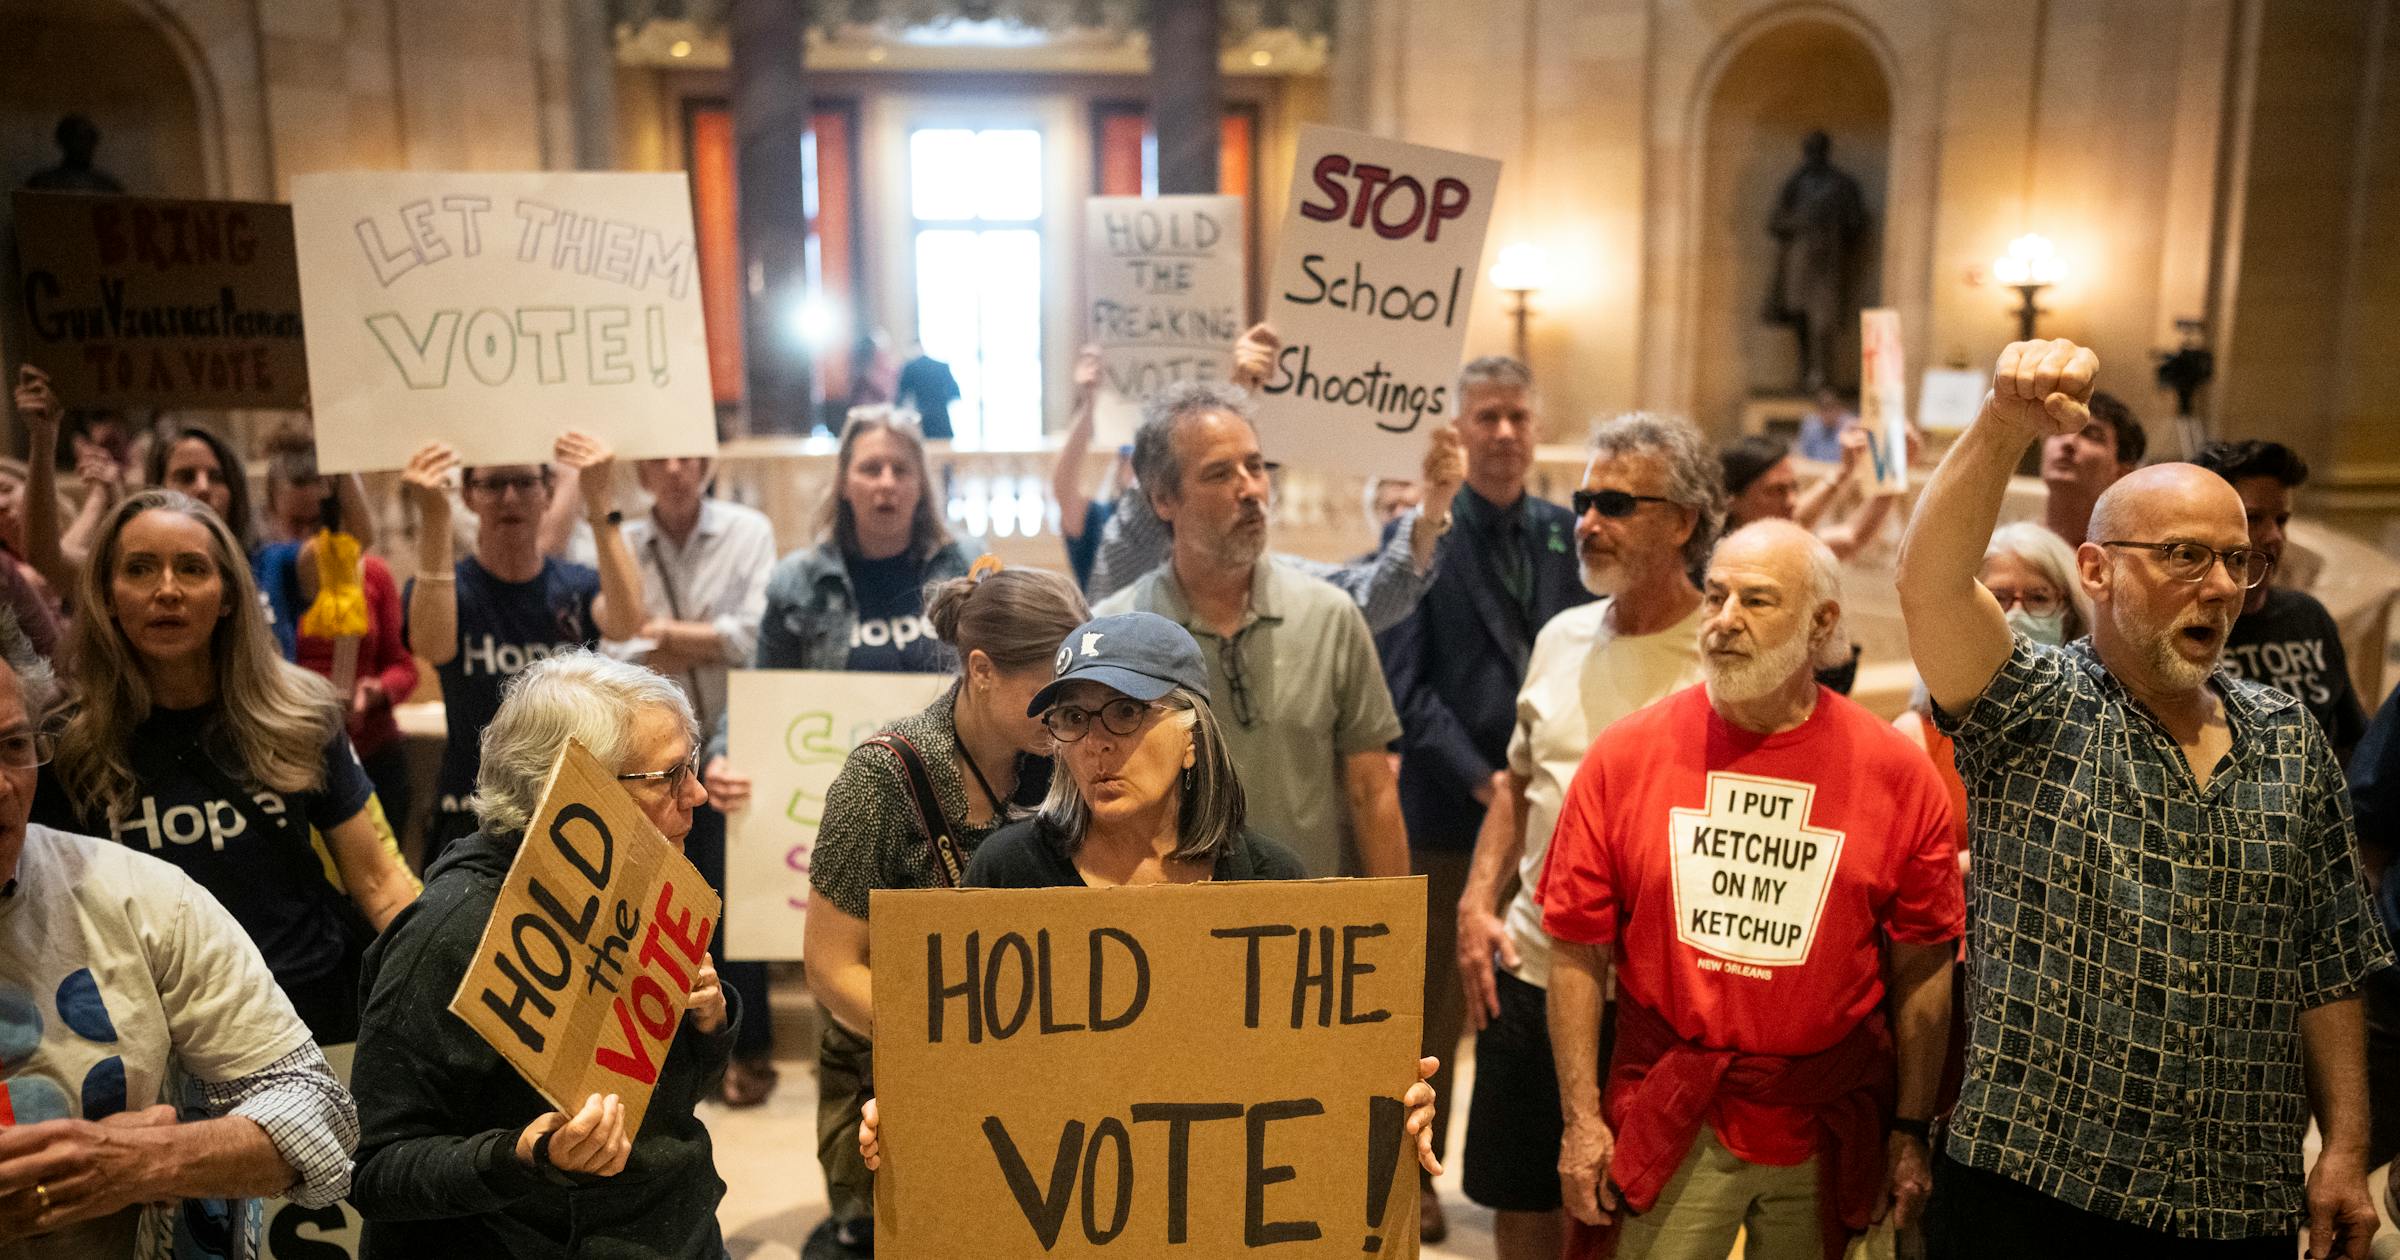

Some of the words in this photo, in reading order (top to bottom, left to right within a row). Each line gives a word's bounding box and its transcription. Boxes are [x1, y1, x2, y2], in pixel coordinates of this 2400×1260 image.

[1103, 210, 1221, 251] HOLD
[1300, 154, 1471, 242] STOP
[92, 203, 260, 270] BRING
[354, 197, 491, 288] LET
[514, 200, 697, 300] THEM
[1127, 260, 1194, 289] THE
[1284, 253, 1463, 328] School
[84, 344, 134, 394] TO
[146, 346, 175, 392] A
[183, 346, 275, 393] VOTE
[364, 304, 671, 390] VOTE!
[1263, 344, 1446, 434] Shootings
[1727, 789, 1737, 813] I
[1743, 792, 1794, 821] PUT
[937, 834, 961, 888] Canon
[1692, 826, 1818, 872] KETCHUP
[1711, 870, 1746, 900] ON
[1751, 876, 1788, 906] MY
[480, 803, 614, 1054] HOLD
[584, 898, 641, 996] the
[1691, 908, 1803, 949] KETCHUP
[595, 880, 712, 1086] VOTE
[927, 927, 1151, 1044] HOLD
[1210, 923, 1393, 1029] THE
[1696, 957, 1722, 972] NEW
[1723, 961, 1773, 981] ORLEANS
[981, 1096, 1405, 1253] VOTE!
